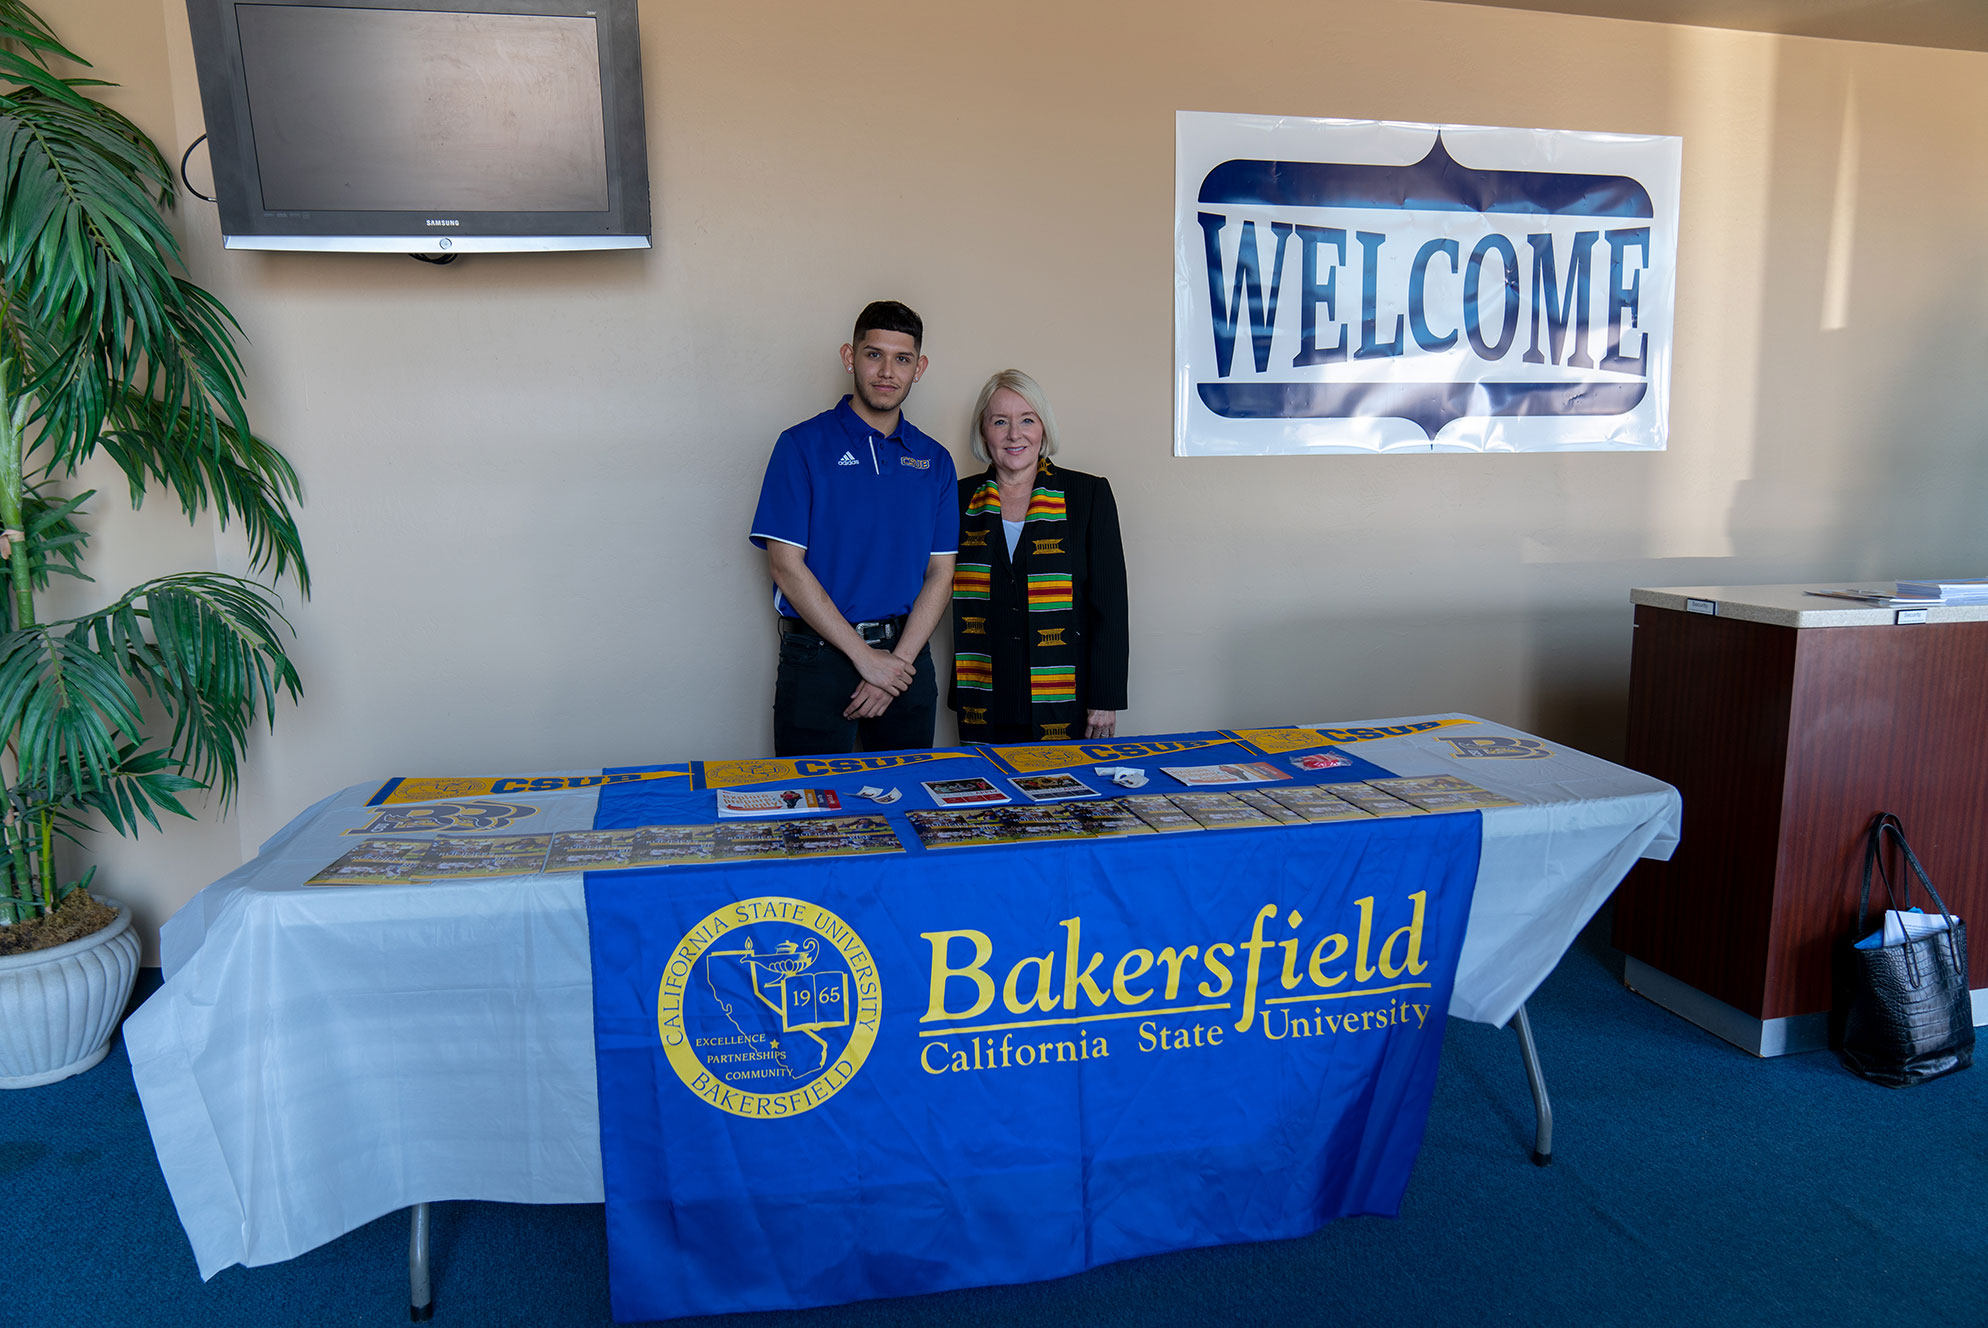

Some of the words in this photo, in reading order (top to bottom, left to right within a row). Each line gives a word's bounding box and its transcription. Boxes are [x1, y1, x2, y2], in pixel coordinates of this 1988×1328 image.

[426, 219, 460, 227] SAMSUNG
[1197, 211, 1651, 378] WELCOME
[1316, 721, 1441, 743] CSUB
[1079, 740, 1209, 761] CSUB
[794, 754, 934, 777] CSUB
[489, 774, 642, 795] CSUB
[919, 889, 1429, 1033] Bakersfield
[663, 916, 729, 1046] CALIFORNIA
[735, 901, 806, 923] STATE
[814, 913, 878, 1032] UNIVERSITY
[792, 989, 811, 1006] 19
[819, 986, 841, 1004] 65
[696, 1033, 766, 1047] EXCELLENCE
[919, 1029, 1110, 1075] California
[1138, 1021, 1224, 1053] State
[1259, 998, 1431, 1040] University
[707, 1051, 787, 1064] PARTNERSHIPS
[725, 1068, 794, 1081] COMMUNITY
[690, 1059, 854, 1116] BAKERSFIELD
